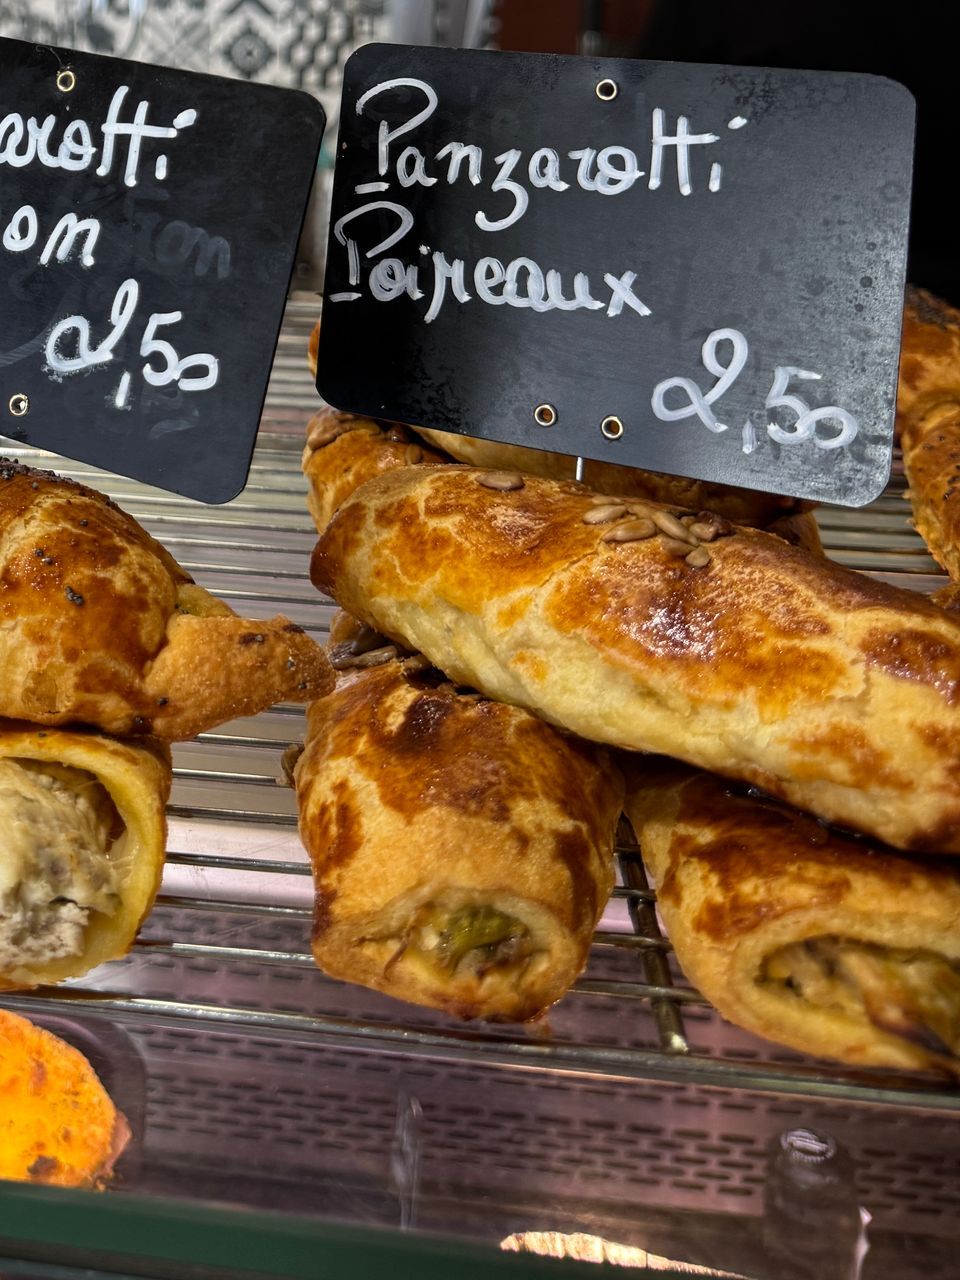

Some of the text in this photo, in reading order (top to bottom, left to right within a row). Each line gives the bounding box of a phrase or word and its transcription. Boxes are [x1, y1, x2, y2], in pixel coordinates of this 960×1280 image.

[354, 77, 748, 233] Panzarotti
[328, 200, 653, 325] Poireaux
[44, 277, 220, 409] 2,50
[650, 327, 858, 454] 2,50
